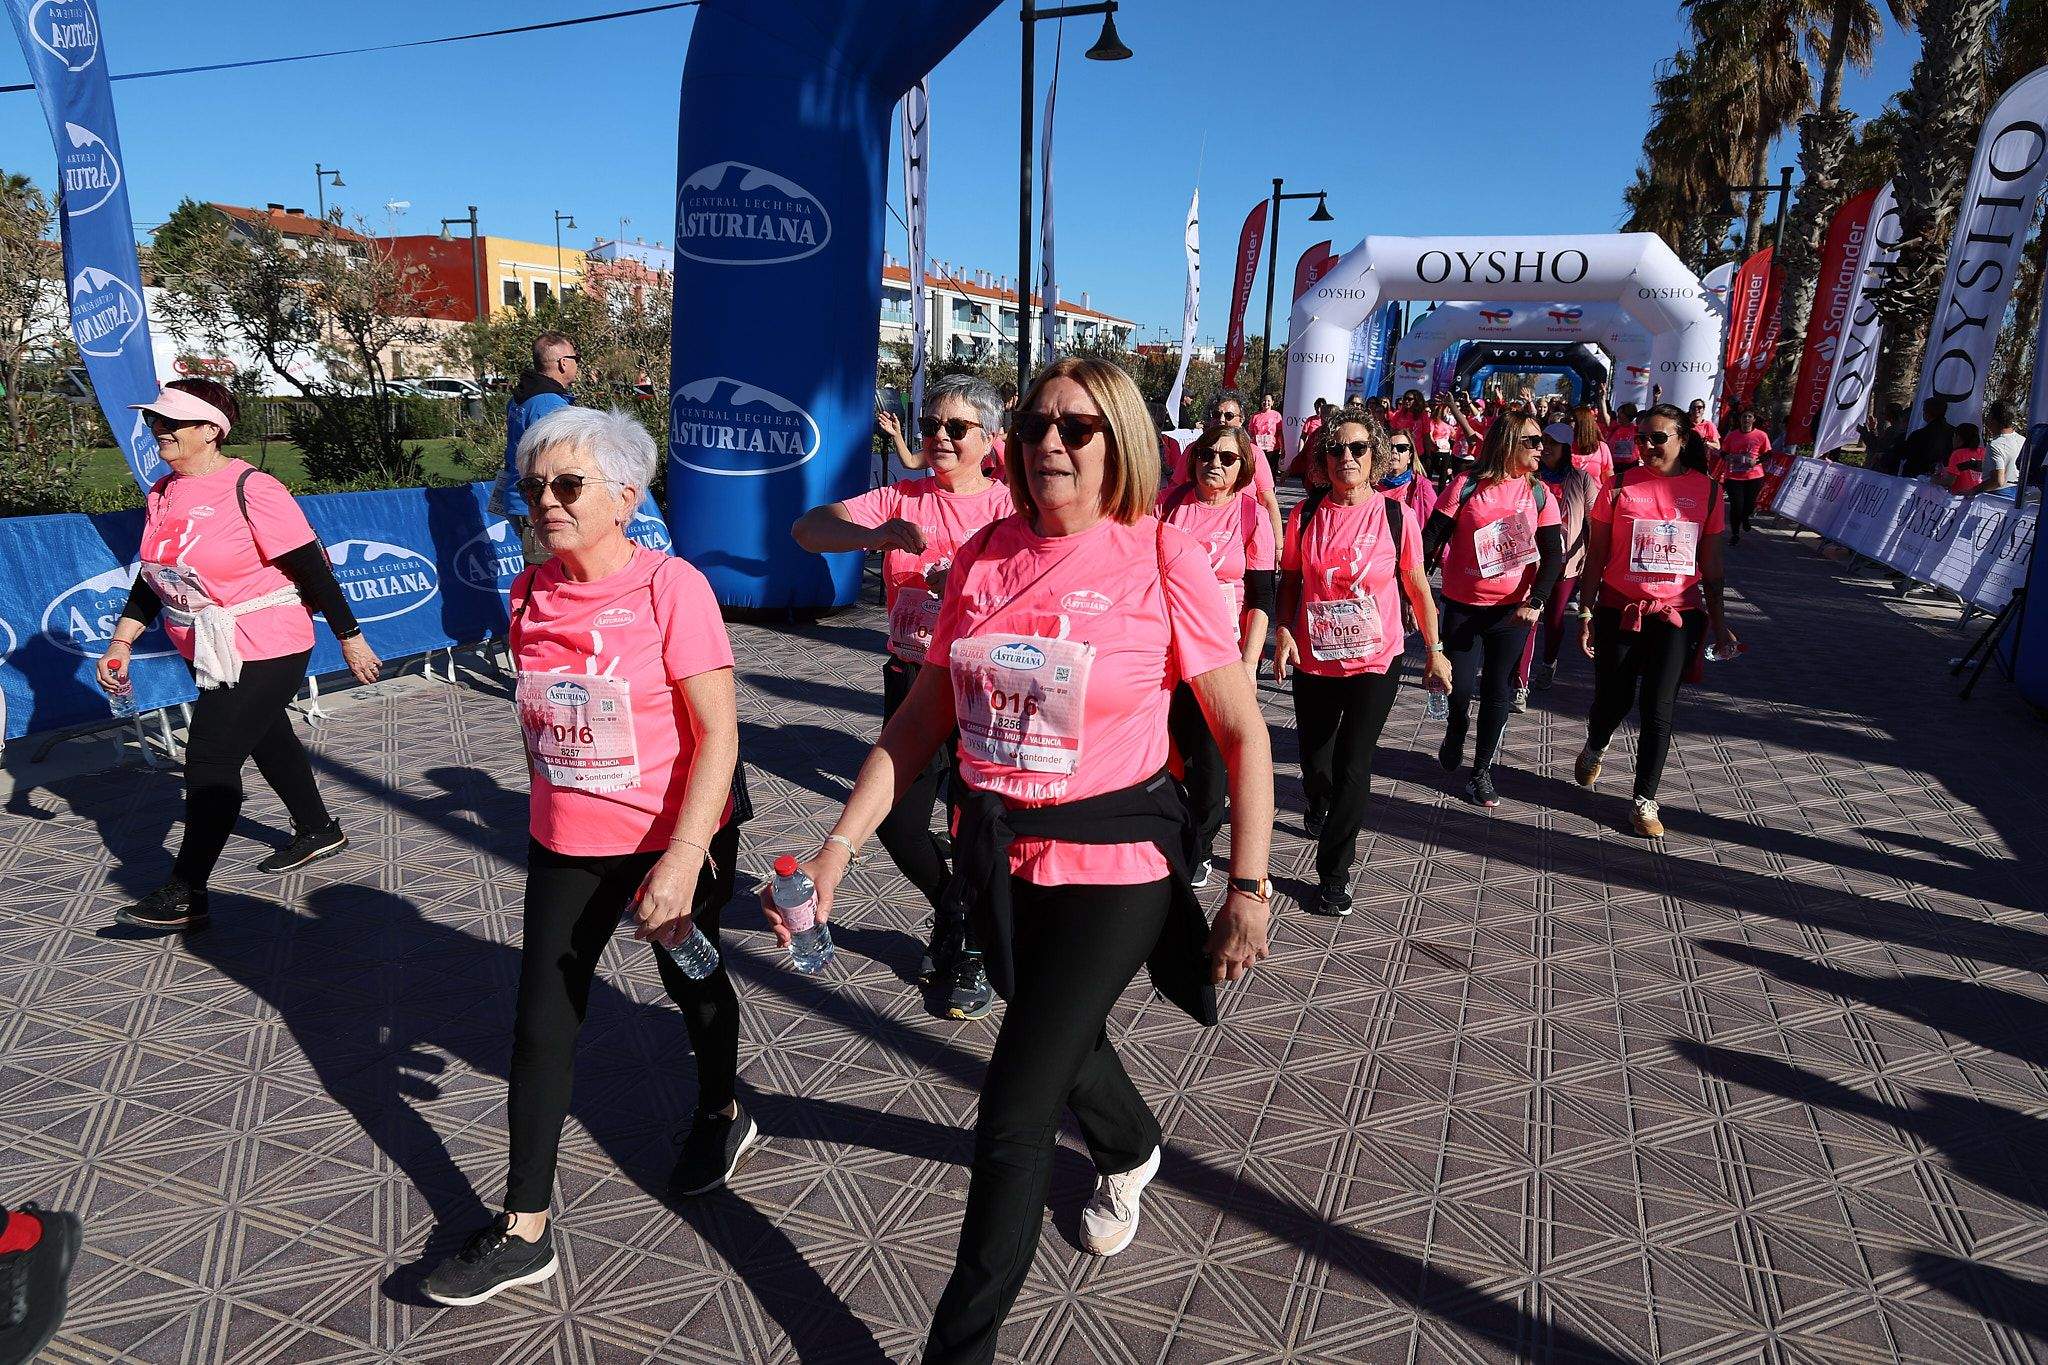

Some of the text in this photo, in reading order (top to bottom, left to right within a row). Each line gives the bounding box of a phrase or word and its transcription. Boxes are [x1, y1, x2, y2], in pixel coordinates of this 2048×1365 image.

[689, 197, 811, 214] CENTRAL LECHERA
[677, 201, 816, 245] ASTURIANA
[1416, 250, 1589, 284] OYSHO
[1932, 120, 2046, 404] OYSHO
[1824, 222, 1865, 332] Santander
[1318, 288, 1366, 299] OYSHO
[1638, 288, 1694, 299] OYSHO
[1740, 274, 1763, 350] Santander
[1292, 352, 1335, 364] OYSHO
[1492, 349, 1565, 359] VOLVO
[1660, 361, 1712, 373] OYSHO
[681, 408, 800, 427] CENTRAL LECHERA
[1286, 416, 1306, 427] OYS
[671, 408, 806, 455] ASTURIANA
[1897, 493, 1957, 543] OYSHO
[1495, 540, 1517, 552] 016
[1976, 512, 2036, 565] OYSH
[1654, 543, 1677, 553] 016
[332, 560, 421, 579] NTRAL LECHERA
[340, 571, 433, 602] TURIANA
[1333, 625, 1360, 637] 016
[993, 649, 1041, 666] ASTURIANA
[549, 690, 588, 702] ASTURIANA
[991, 689, 1039, 716] 016
[998, 717, 1021, 730] 8256
[553, 724, 594, 744] 016
[1029, 735, 1061, 747] VALENCIA
[560, 747, 580, 758] 8257
[1019, 751, 1063, 764] Santander
[569, 759, 586, 767] MUJER
[592, 758, 620, 767] VALENCIA
[585, 772, 623, 782] Santander
[1007, 778, 1021, 795] LA
